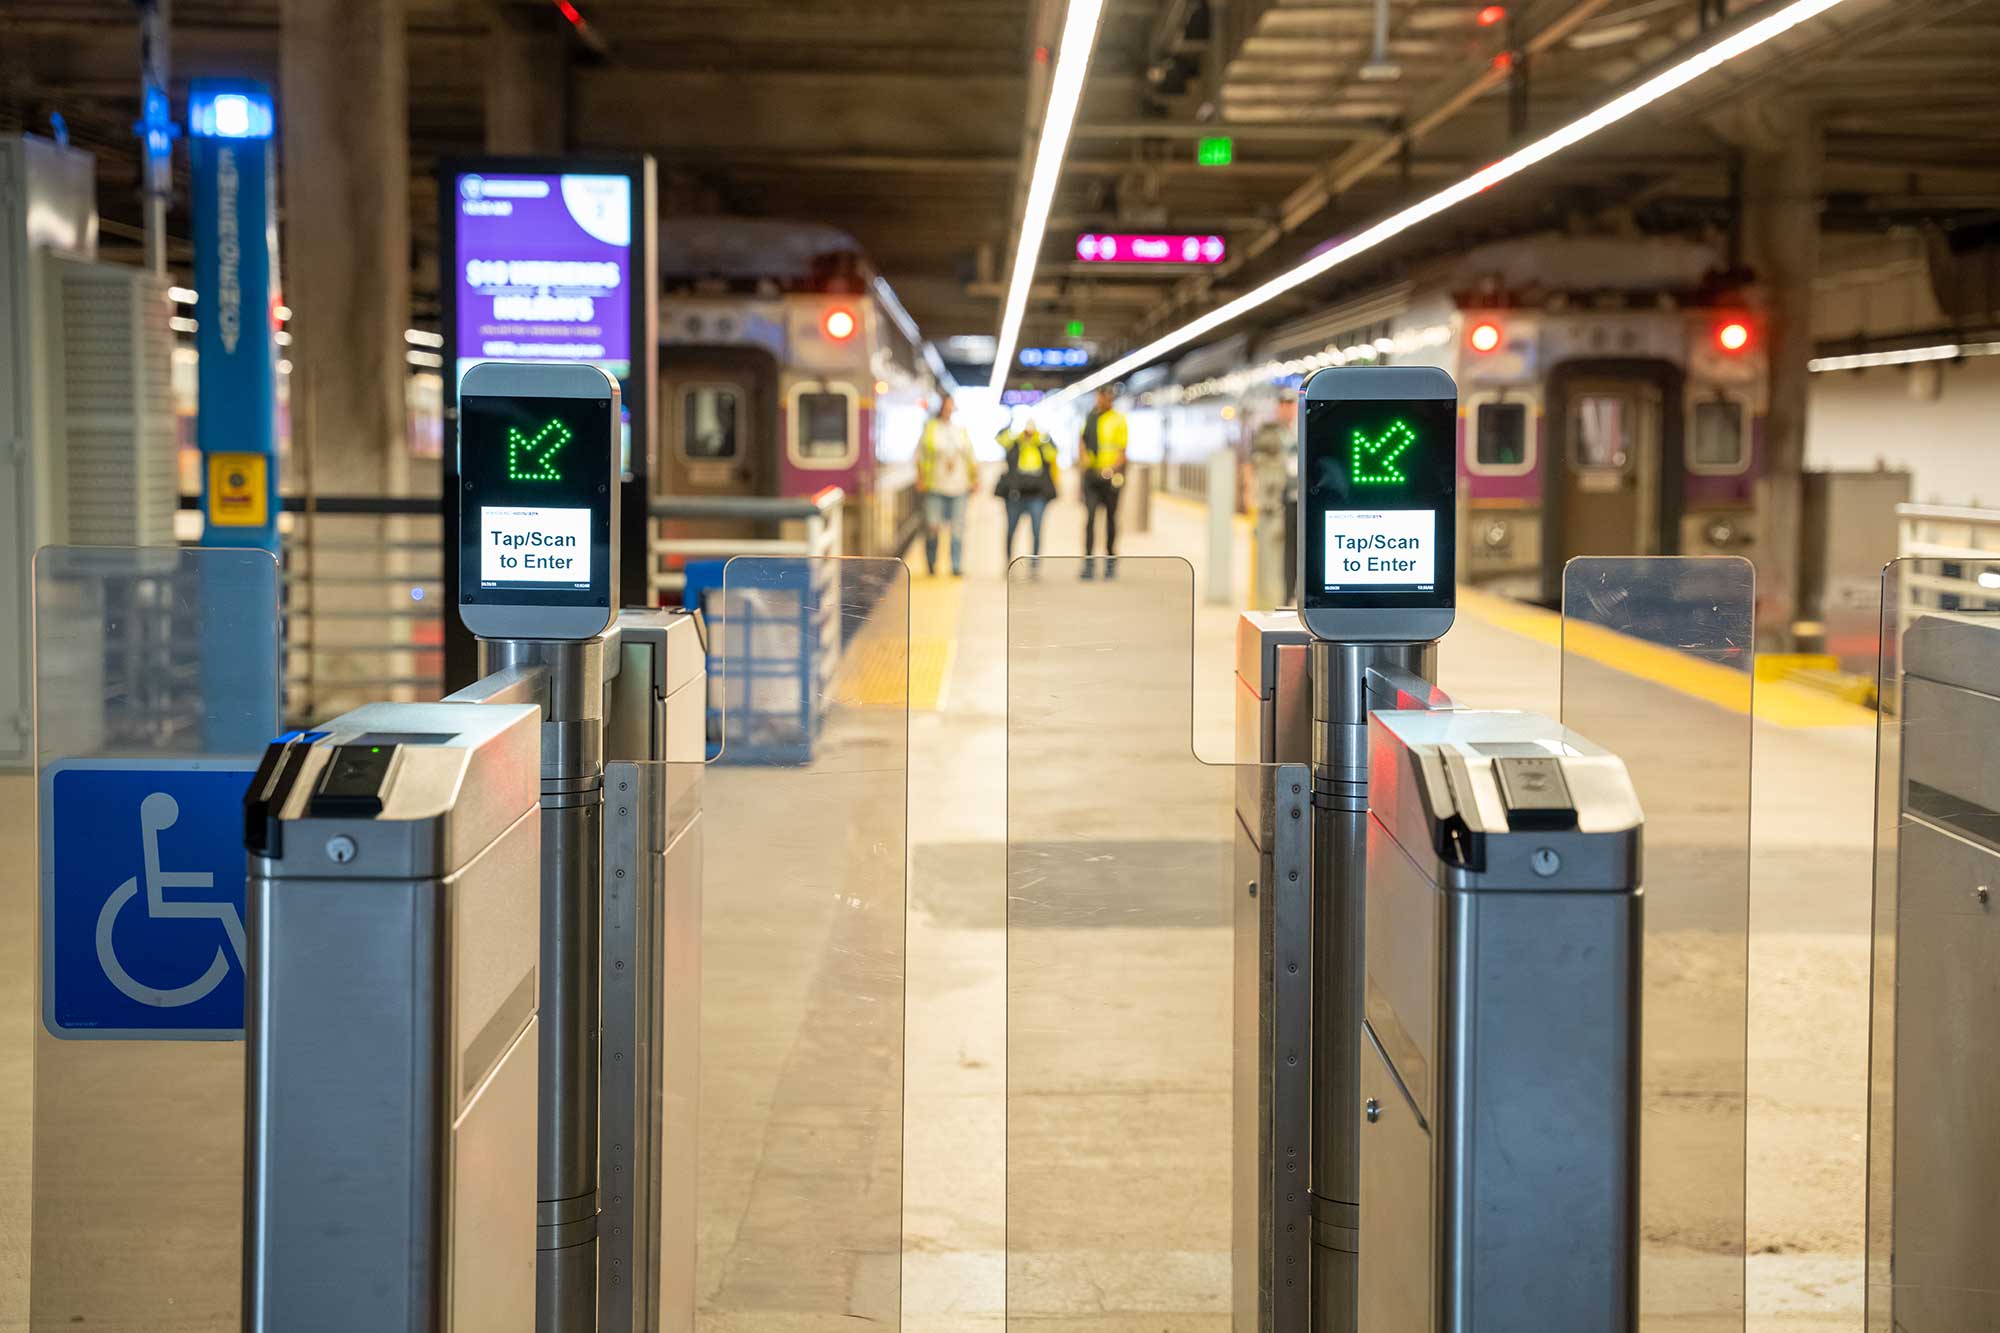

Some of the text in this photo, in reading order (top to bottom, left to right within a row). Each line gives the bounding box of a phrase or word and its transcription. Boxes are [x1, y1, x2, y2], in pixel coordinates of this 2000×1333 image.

[490, 530, 575, 549] Tap/Scan
[1334, 534, 1418, 552] Tap/Scan
[499, 553, 572, 568] to Enter
[1343, 557, 1416, 571] to Enter
